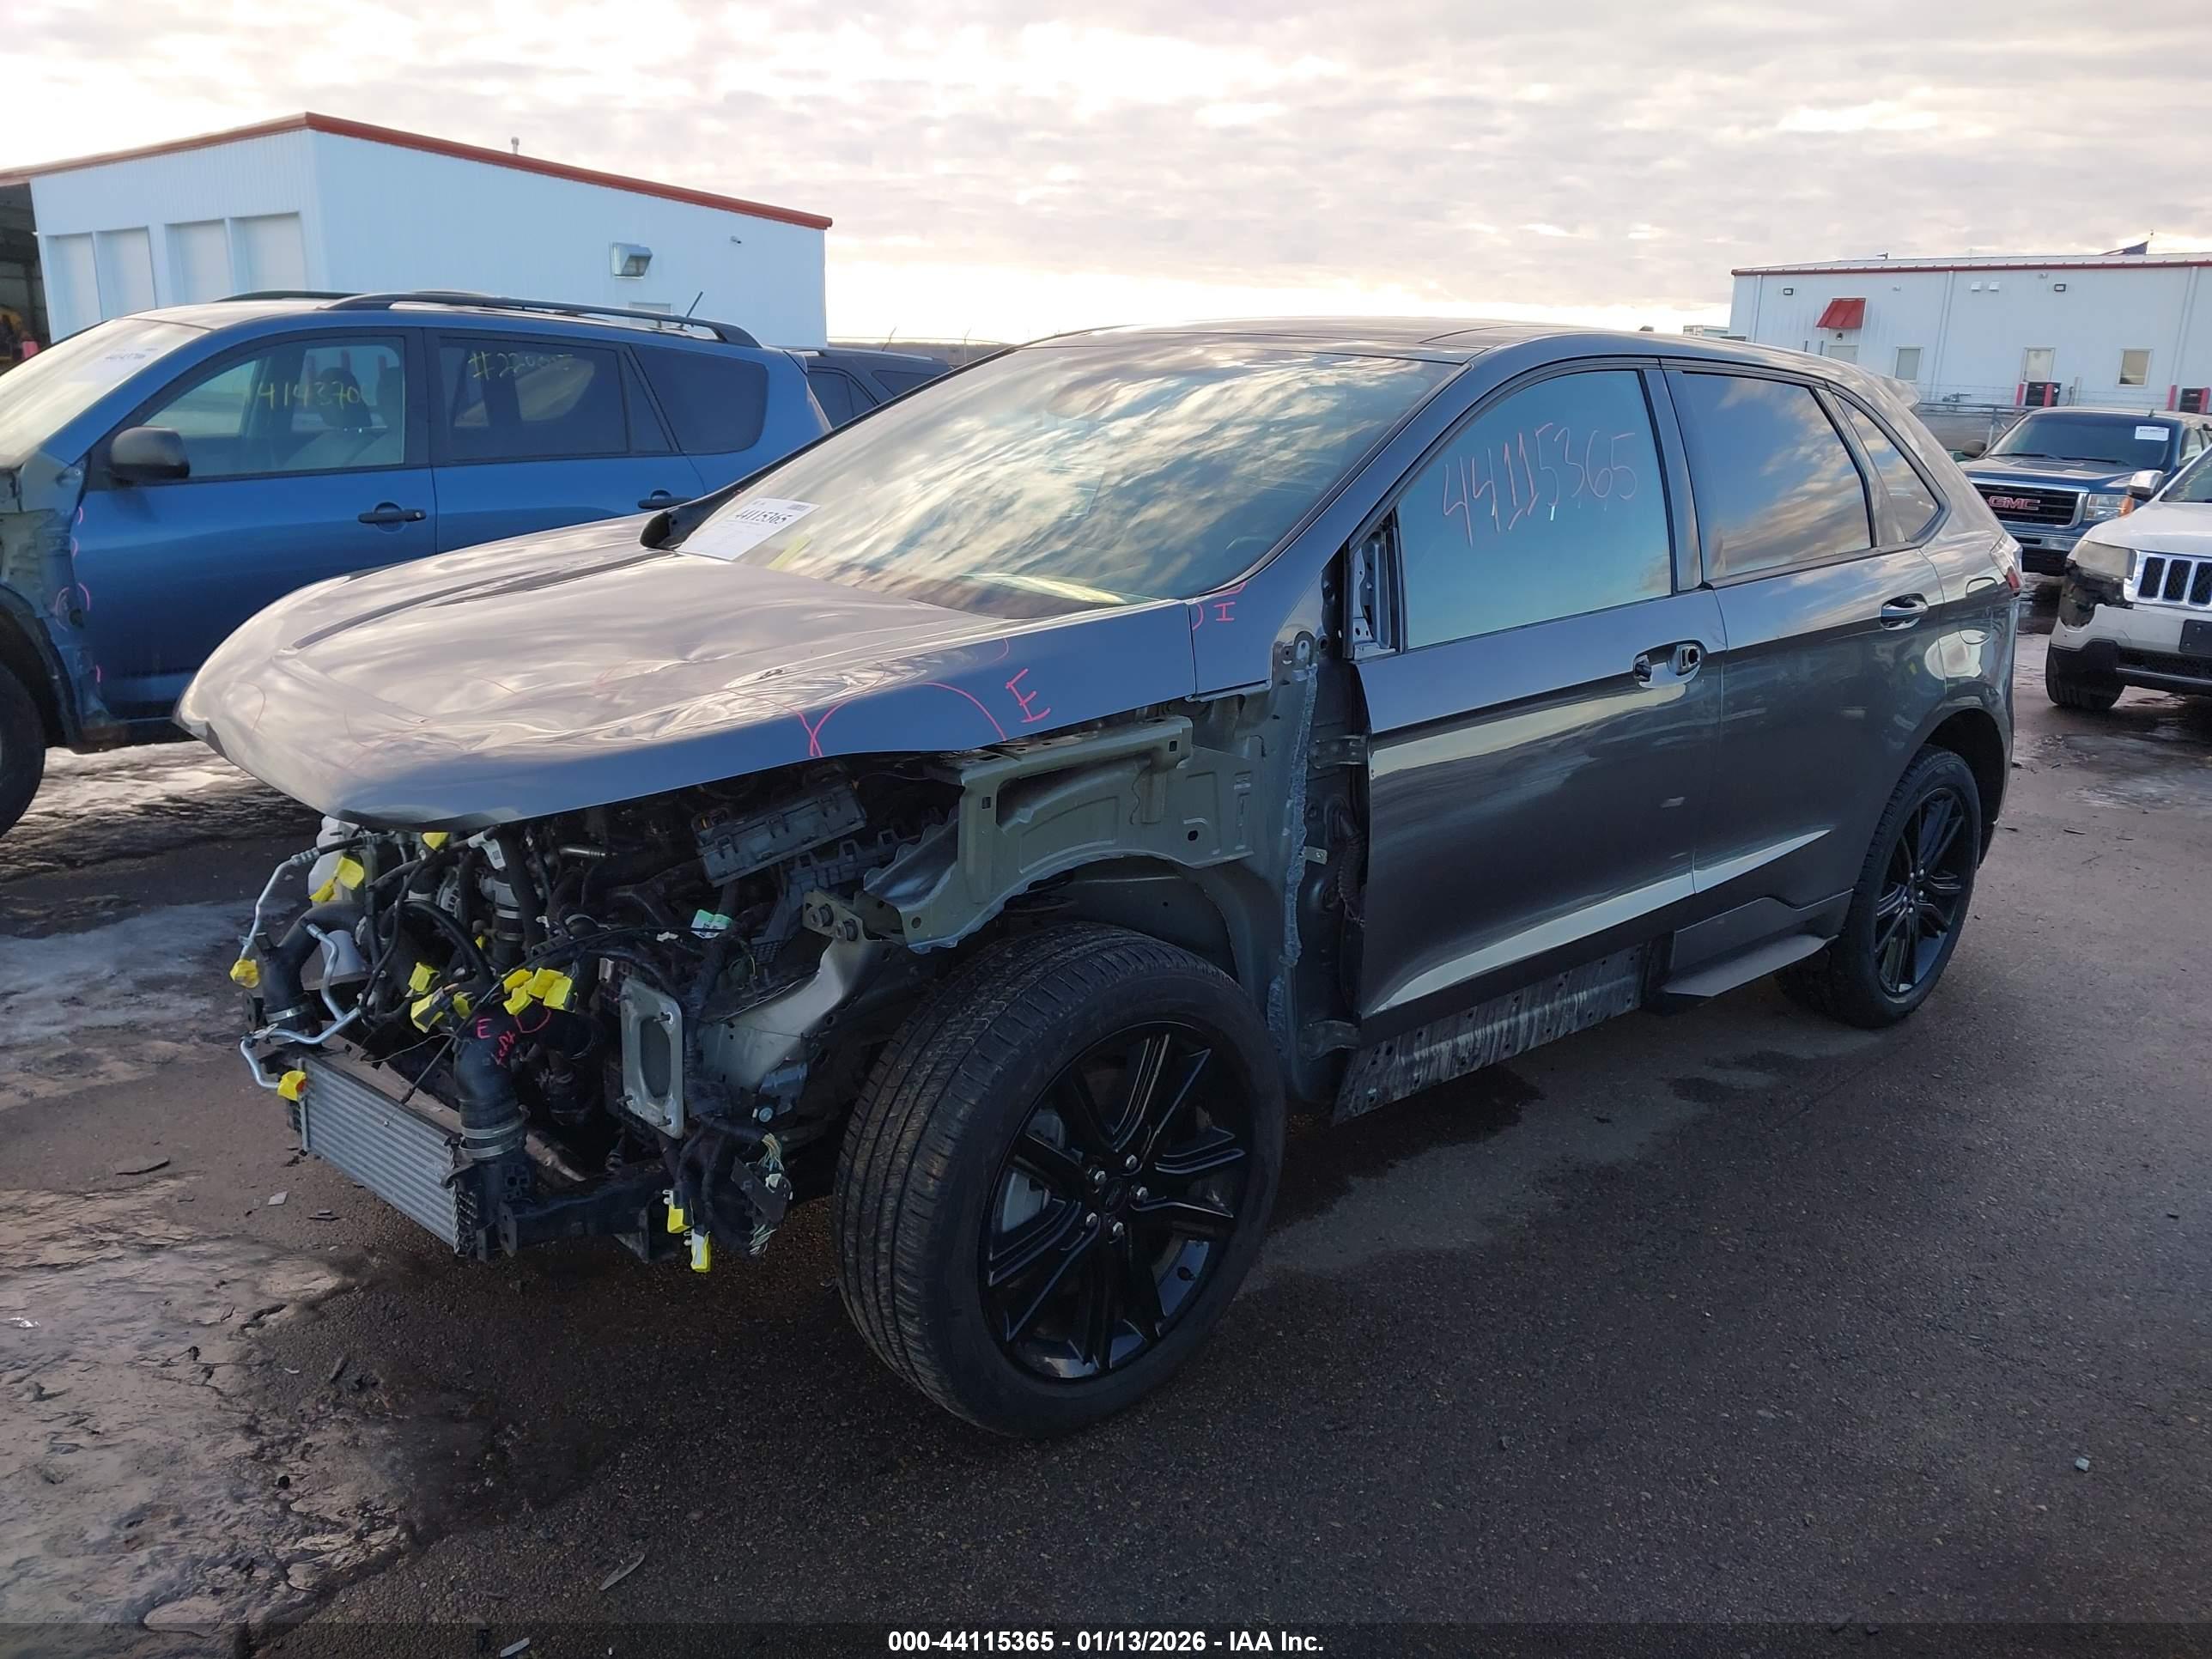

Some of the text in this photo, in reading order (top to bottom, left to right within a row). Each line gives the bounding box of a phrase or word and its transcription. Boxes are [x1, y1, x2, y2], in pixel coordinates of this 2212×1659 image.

[1443, 422, 1638, 549] 44115365
[1989, 495, 2041, 511] GMC
[1005, 668, 1052, 723] E
[477, 1018, 493, 1039] E
